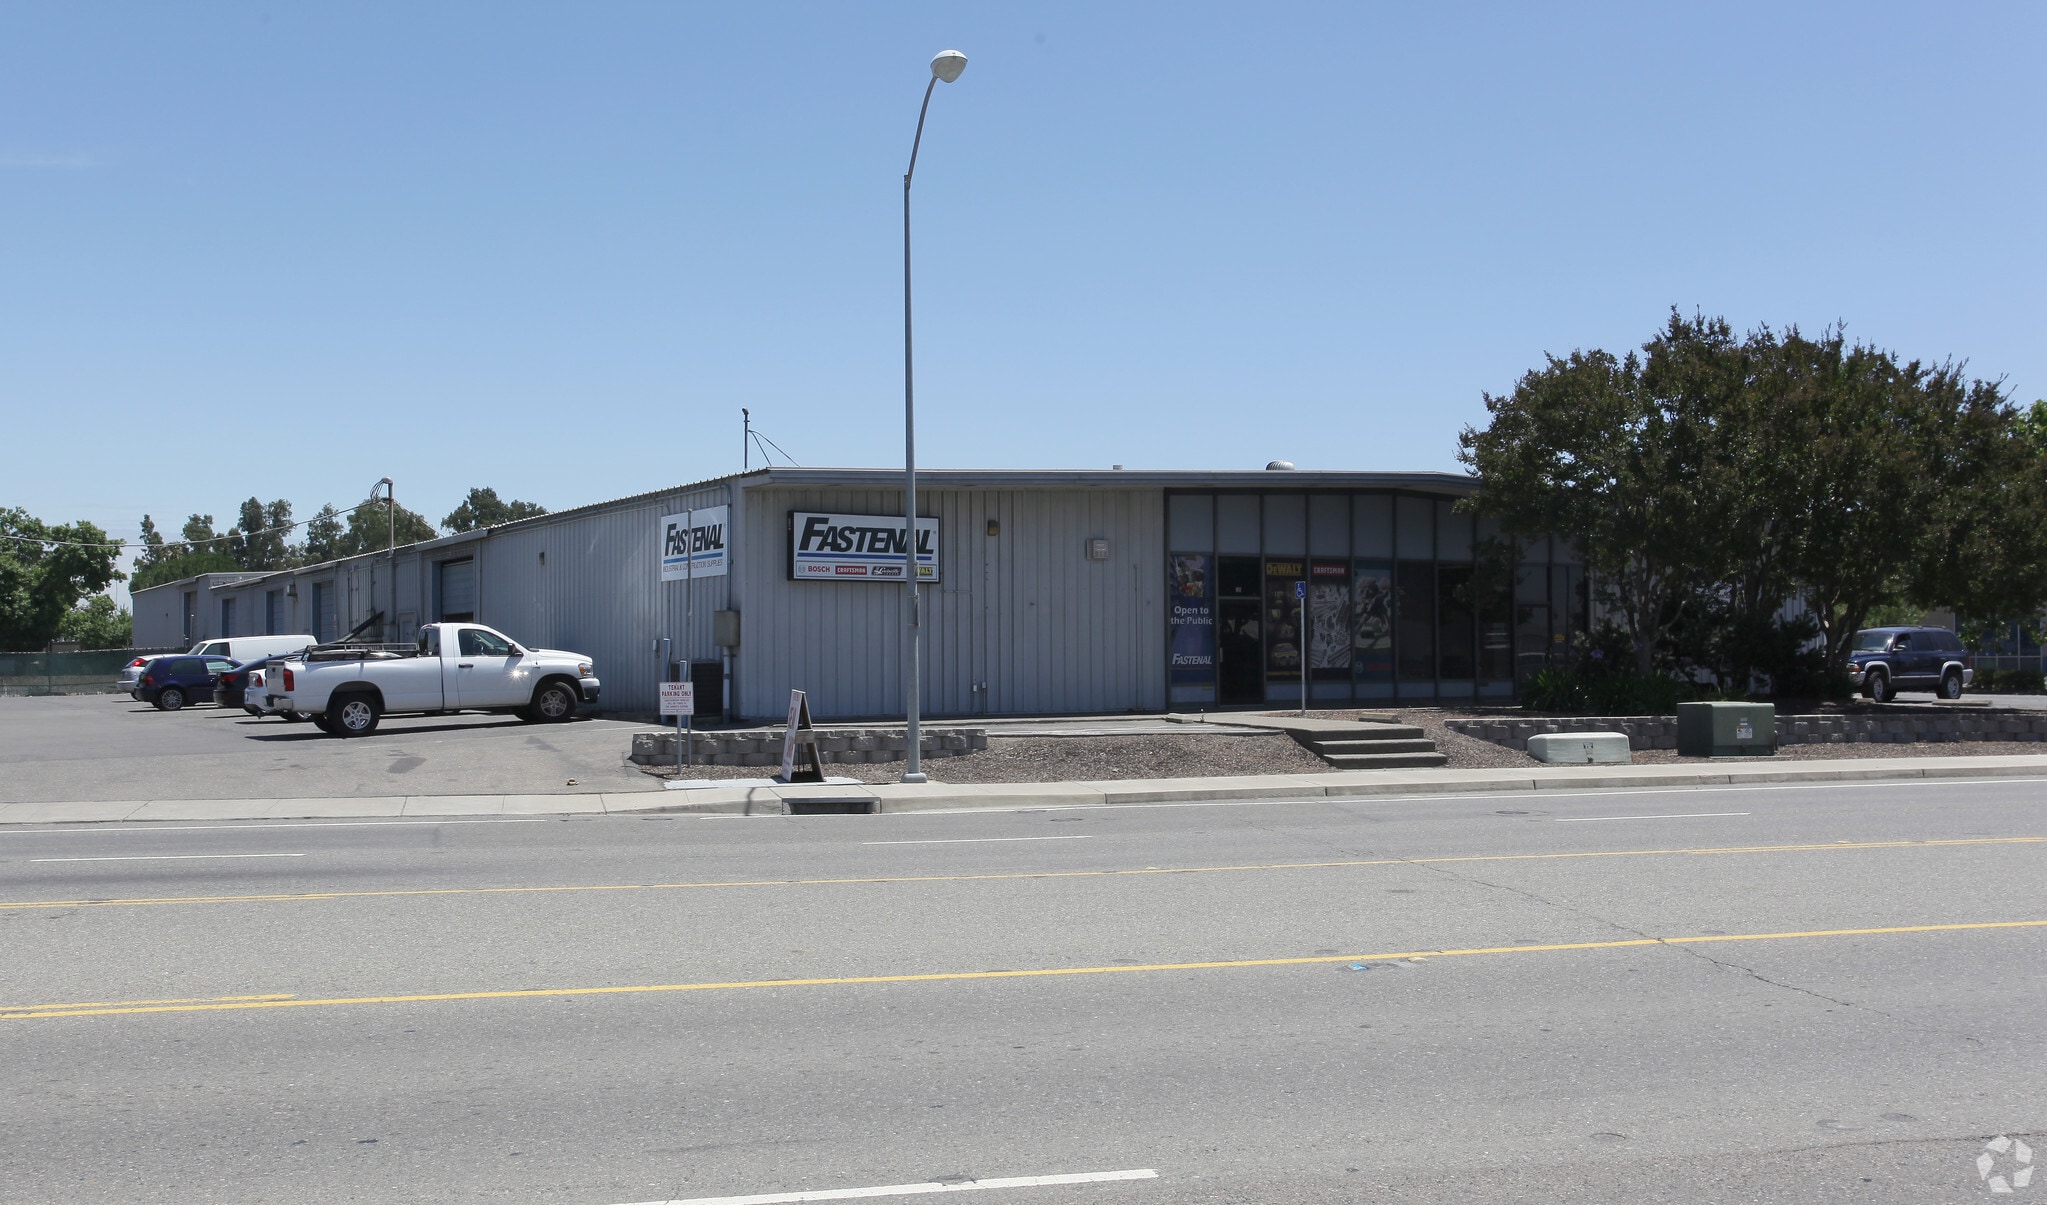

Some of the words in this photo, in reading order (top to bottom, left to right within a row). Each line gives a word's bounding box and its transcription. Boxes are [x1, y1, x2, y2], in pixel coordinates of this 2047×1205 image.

[807, 565, 831, 573] BOSCH
[1174, 605, 1198, 616] Open
[1200, 606, 1209, 614] to
[1170, 616, 1185, 625] the
[1187, 616, 1213, 625] Public
[1172, 653, 1213, 665] FASTENAL
